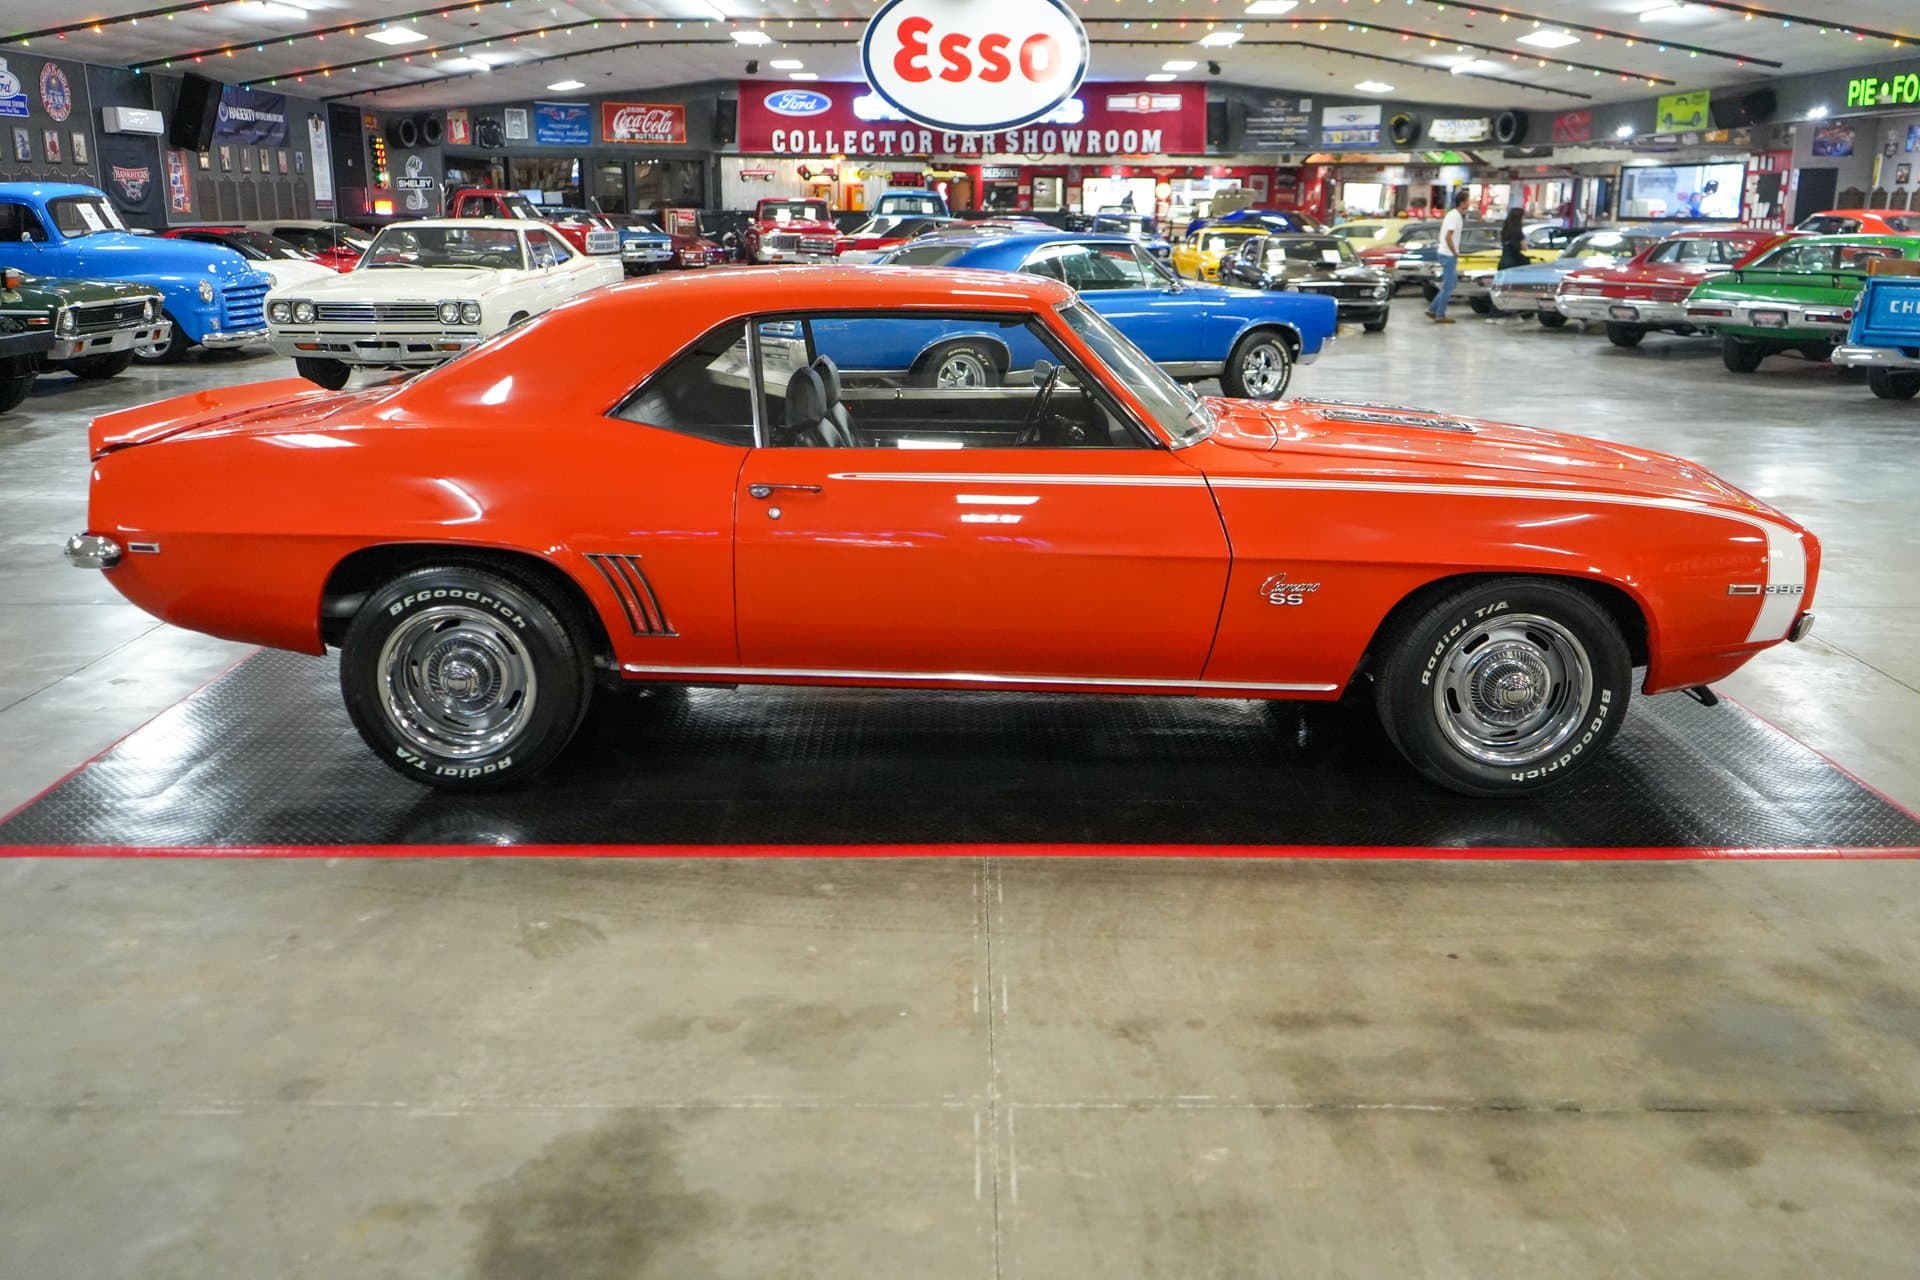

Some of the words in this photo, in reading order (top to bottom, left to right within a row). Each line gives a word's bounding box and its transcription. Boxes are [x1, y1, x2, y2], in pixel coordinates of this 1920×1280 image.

[778, 93, 818, 110] Ford
[1847, 78, 1878, 107] PIE
[1892, 73, 1920, 104] FO
[228, 106, 255, 122] HAGERTY
[613, 108, 674, 133] Coca-Cola
[771, 129, 933, 154] COLLECTOR
[943, 131, 996, 153] CAR
[1005, 129, 1163, 154] SHOWROOM
[399, 179, 432, 189] SHELBY
[1260, 572, 1321, 596] Camaro
[1766, 584, 1804, 594] 396
[389, 589, 527, 629] BFGoodrich
[1269, 593, 1303, 605] SS
[1421, 618, 1467, 686] Radial
[1474, 601, 1510, 619] T/A
[1511, 688, 1612, 782] BFGoodrich
[395, 746, 427, 770] T/A
[435, 756, 513, 778] Radial
